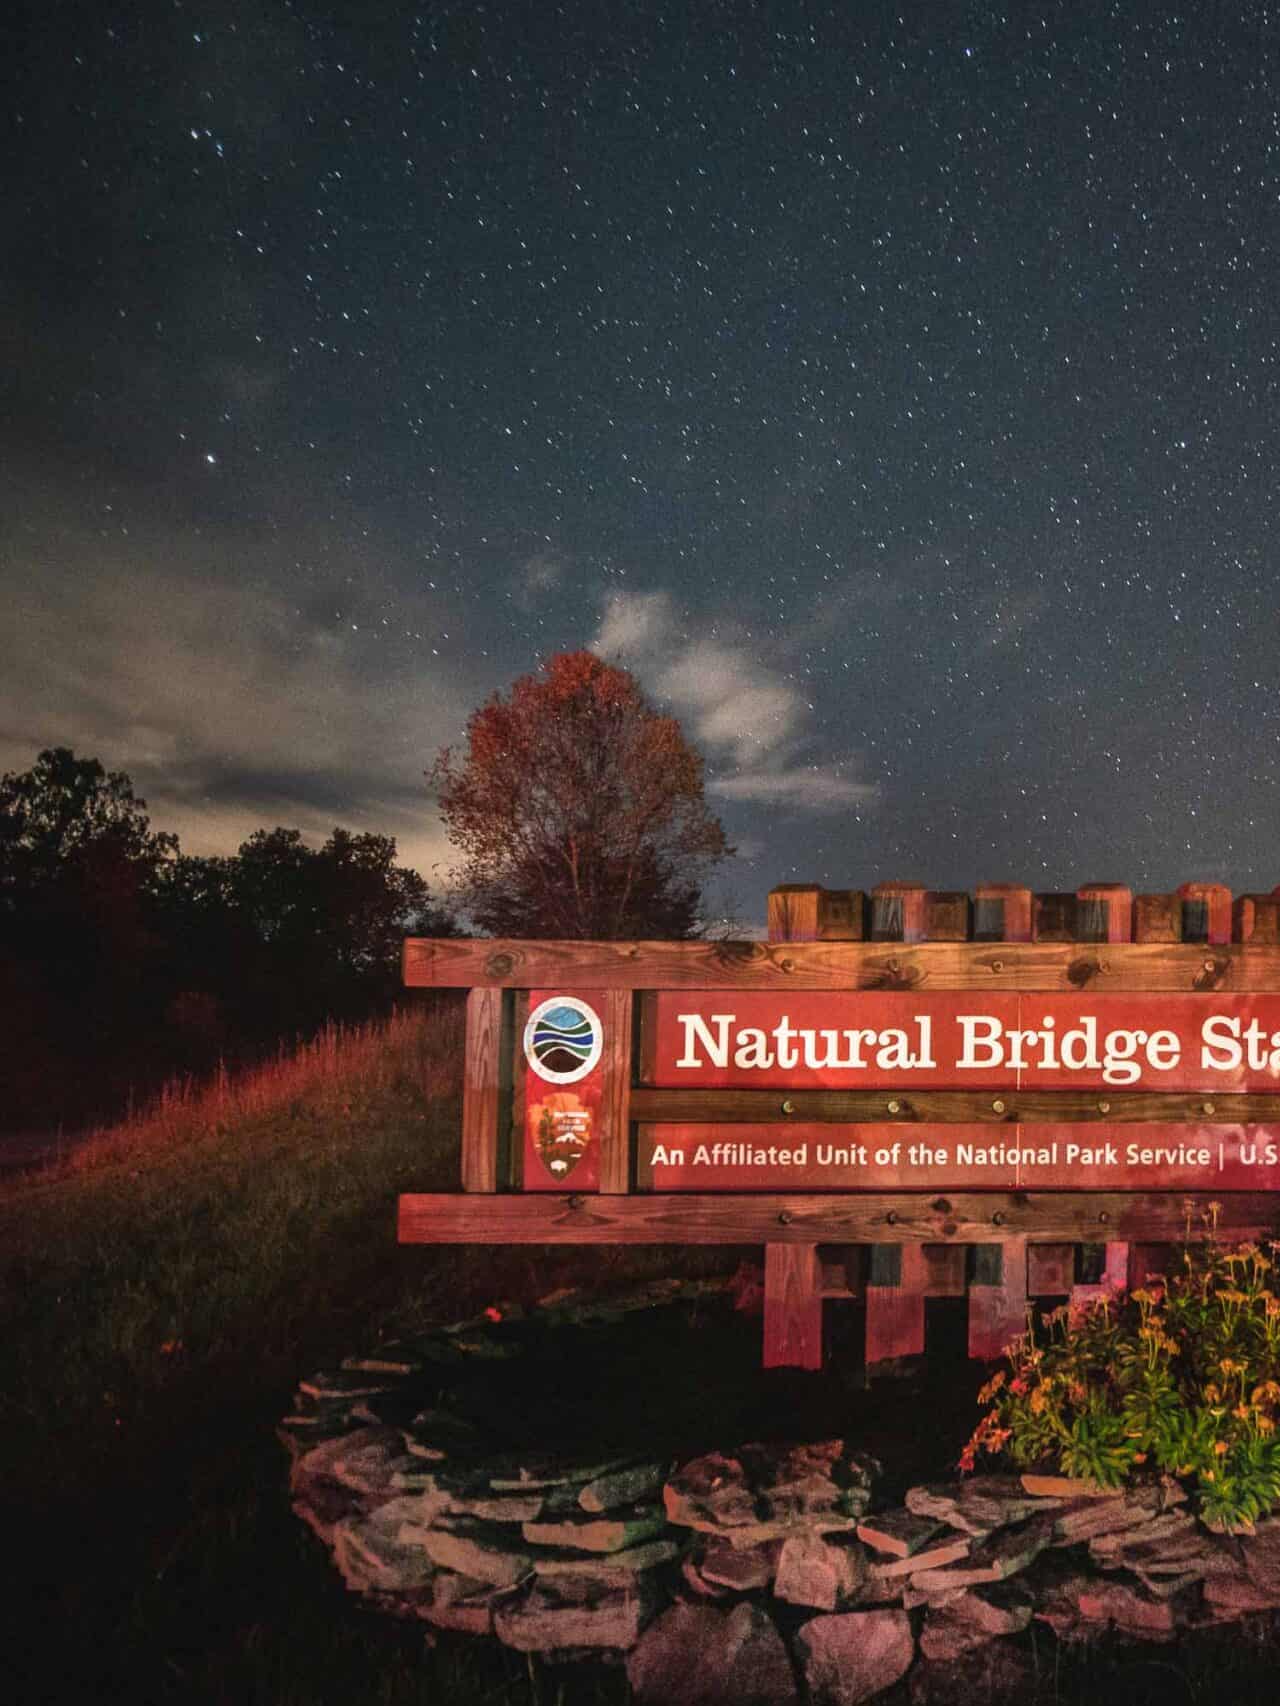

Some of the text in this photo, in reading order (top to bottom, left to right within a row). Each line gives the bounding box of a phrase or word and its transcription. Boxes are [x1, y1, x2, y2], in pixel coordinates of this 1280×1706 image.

[676, 1014, 936, 1068] Natural
[955, 1015, 1181, 1084] Bridge
[651, 1145, 684, 1166] An
[693, 1144, 807, 1166] Affiliated
[816, 1144, 867, 1166] Unit
[874, 1144, 901, 1166] of
[907, 1144, 948, 1166] the
[956, 1144, 1057, 1166] National
[1066, 1144, 1117, 1166] Park
[1126, 1144, 1211, 1166] Service
